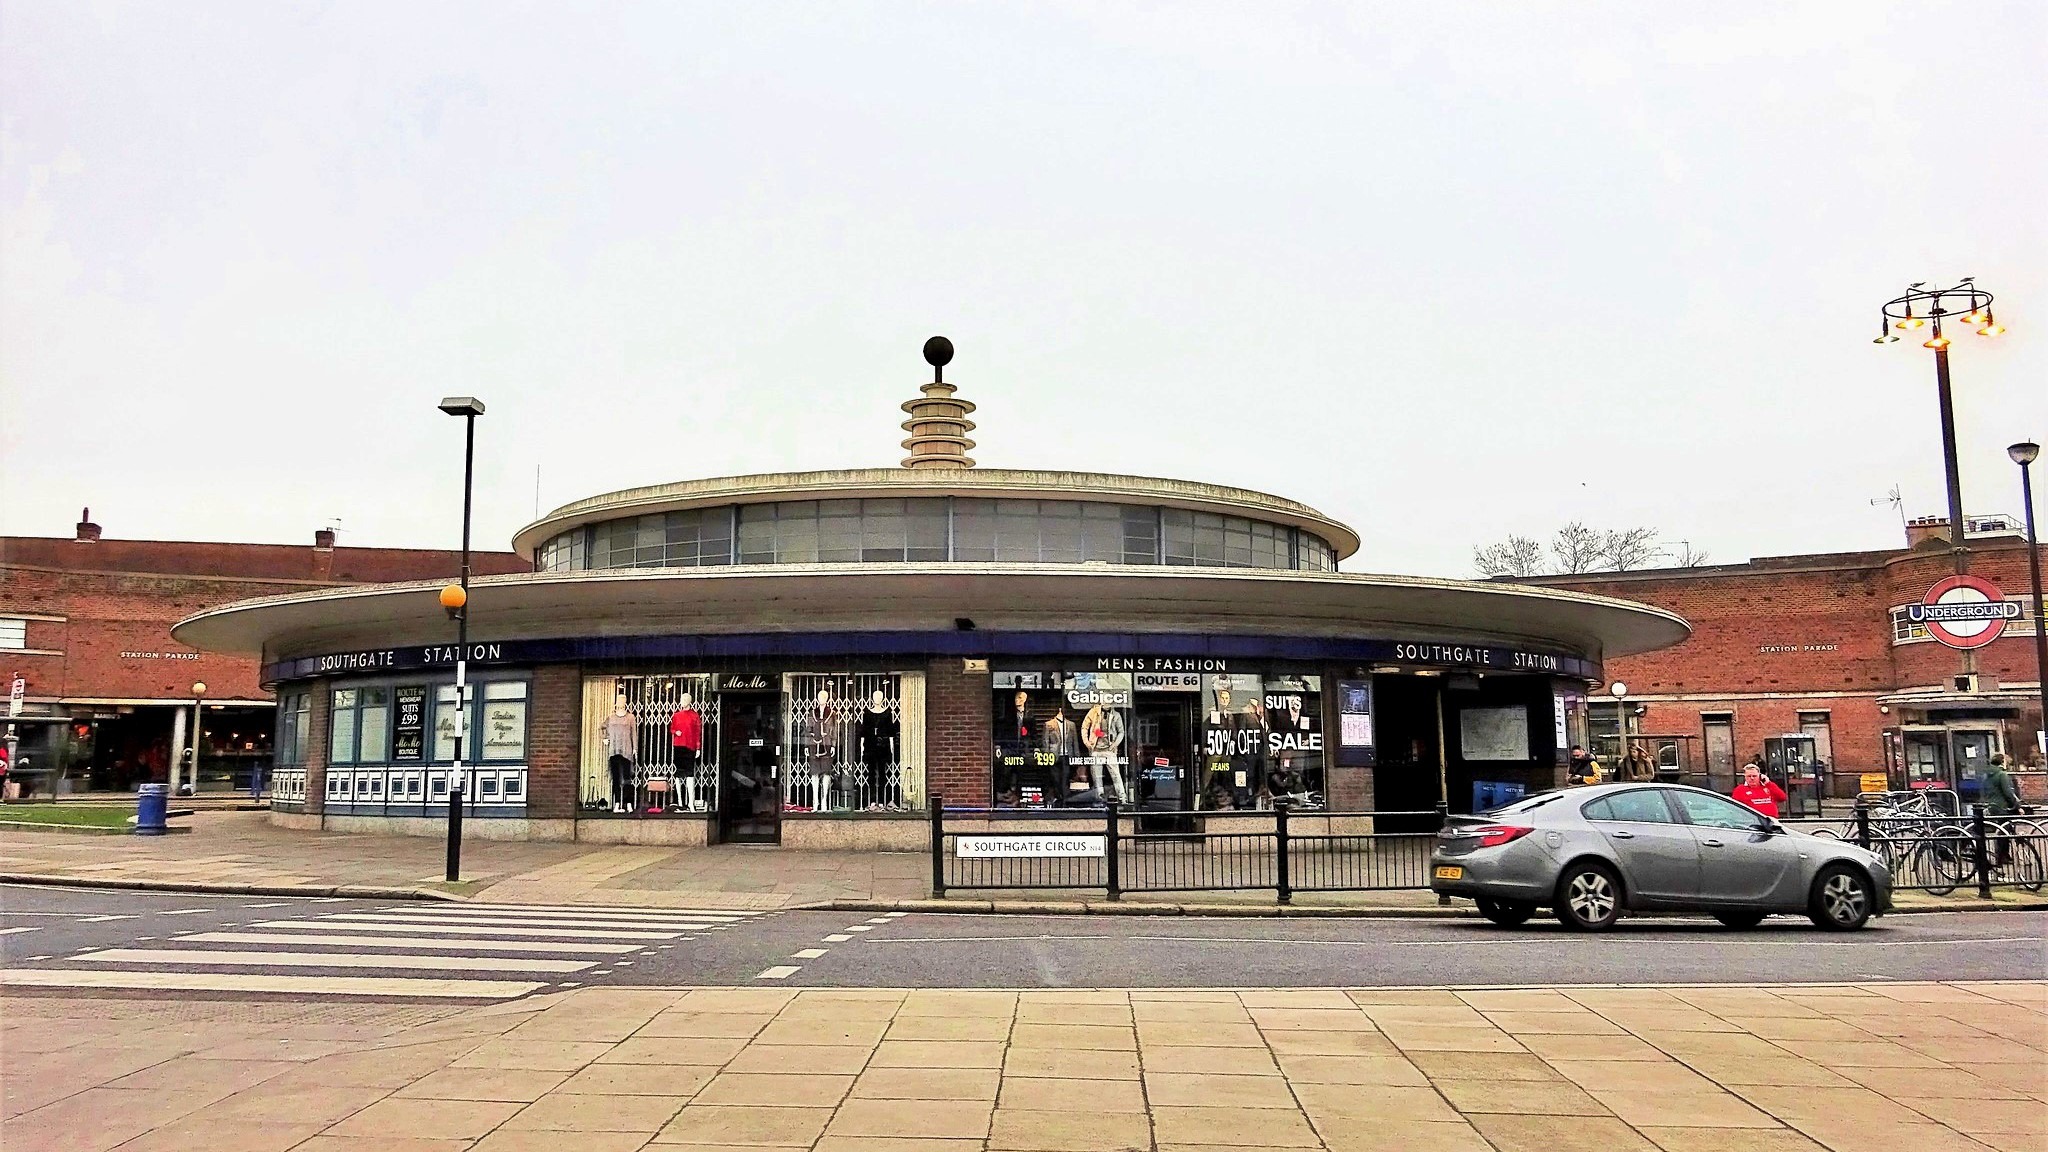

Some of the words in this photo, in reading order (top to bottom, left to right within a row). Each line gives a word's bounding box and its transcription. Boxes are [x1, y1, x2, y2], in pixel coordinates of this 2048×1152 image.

[1909, 602, 2020, 621] UNDERGROUND
[120, 651, 159, 659] STATION
[1760, 645, 1798, 653] STATION
[1804, 644, 1839, 652] PARADE
[320, 651, 394, 670] SOUTHGATE
[1396, 644, 1490, 664] SOUTHGATE
[1514, 652, 1557, 670] STATION
[1097, 658, 1145, 670] MENS
[1154, 659, 1227, 671] FASHION
[1137, 676, 1179, 686] ROUTE
[1183, 676, 1198, 686] 66
[1067, 690, 1128, 704] Gabicci
[1265, 694, 1302, 710] SUITS
[402, 704, 419, 713] SUITS
[401, 714, 418, 725] £99
[1207, 729, 1236, 756] 50%
[1237, 729, 1260, 755] OFF
[1268, 732, 1323, 750] SALE
[1004, 756, 1025, 766] SUITS
[1036, 752, 1055, 766] £99
[1210, 762, 1230, 771] JEANS
[974, 842, 1041, 852] SOUTHGATE
[1045, 842, 1087, 851] CIRCUS
